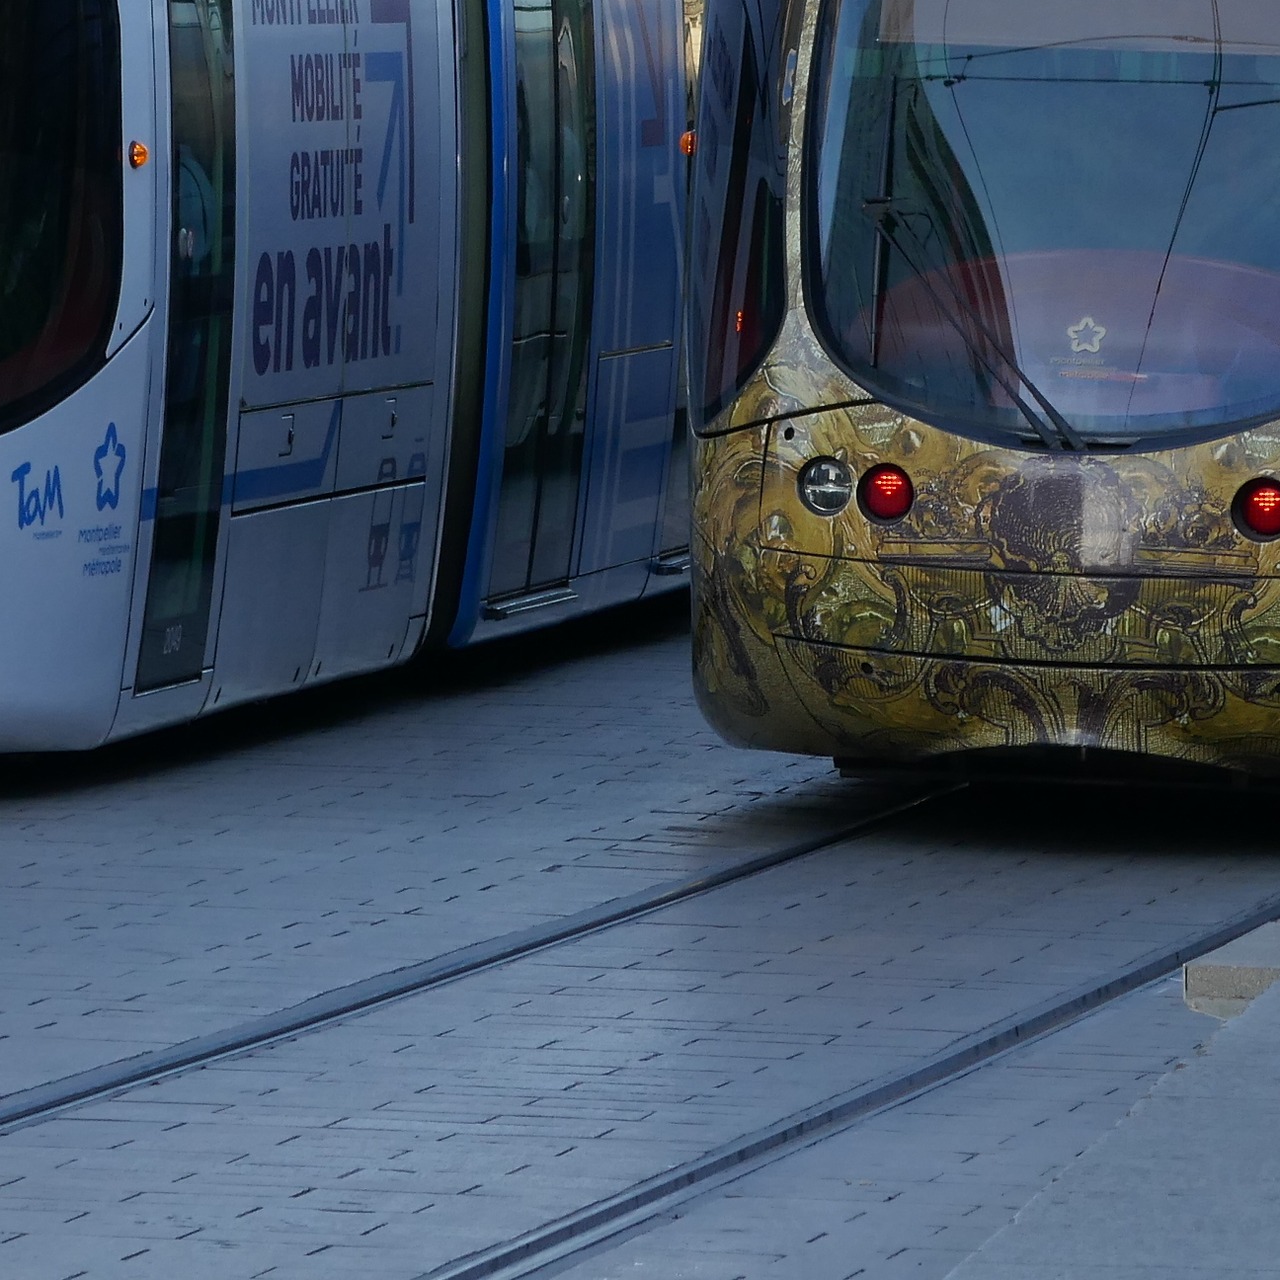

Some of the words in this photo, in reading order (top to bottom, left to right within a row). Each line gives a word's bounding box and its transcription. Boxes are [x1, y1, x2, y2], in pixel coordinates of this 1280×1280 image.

[290, 29, 363, 123] MOBILITÉ
[290, 125, 363, 222] GRATUITÉ
[252, 249, 296, 377] en
